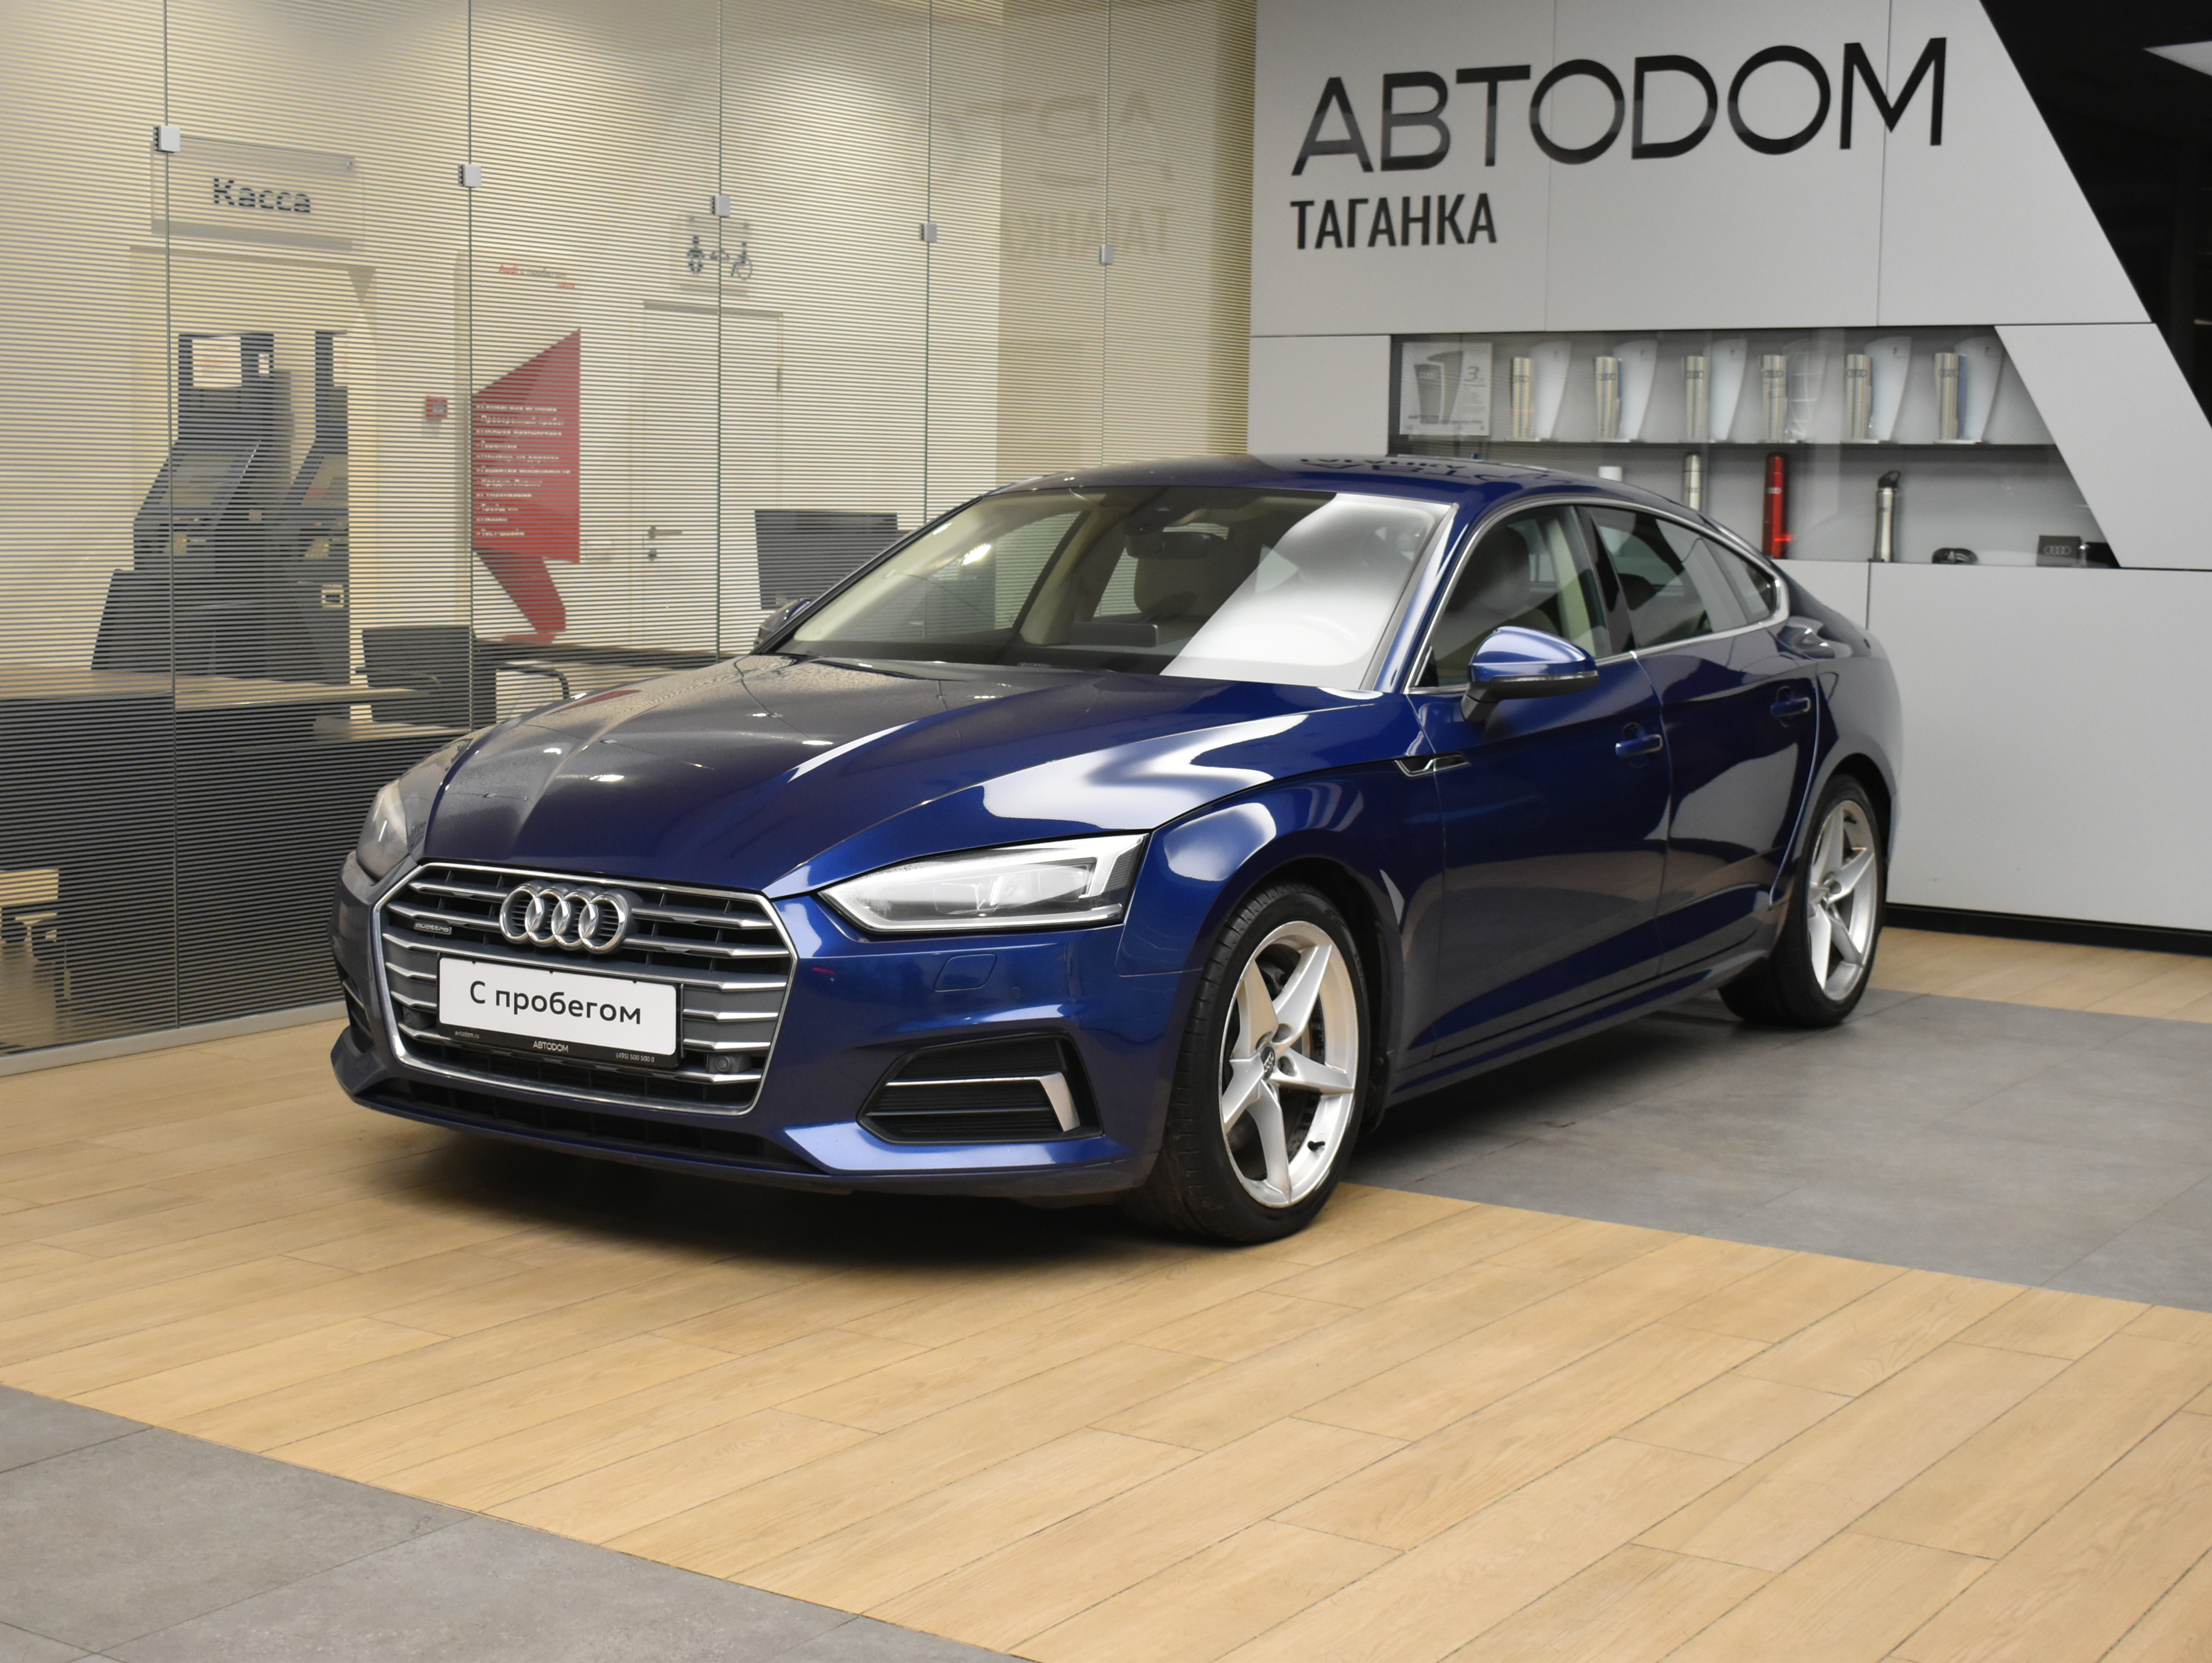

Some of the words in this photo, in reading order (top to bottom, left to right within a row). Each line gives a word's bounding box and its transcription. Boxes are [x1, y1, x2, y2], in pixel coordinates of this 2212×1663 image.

[214, 178, 311, 213] Касса
[1290, 193, 1497, 250] ТАГАНКА
[415, 923, 449, 932] quattro
[470, 980, 485, 1004] С
[496, 990, 640, 1024] пробегом
[454, 1030, 480, 1039] avtodom.ru
[616, 1052, 629, 1060] (495)
